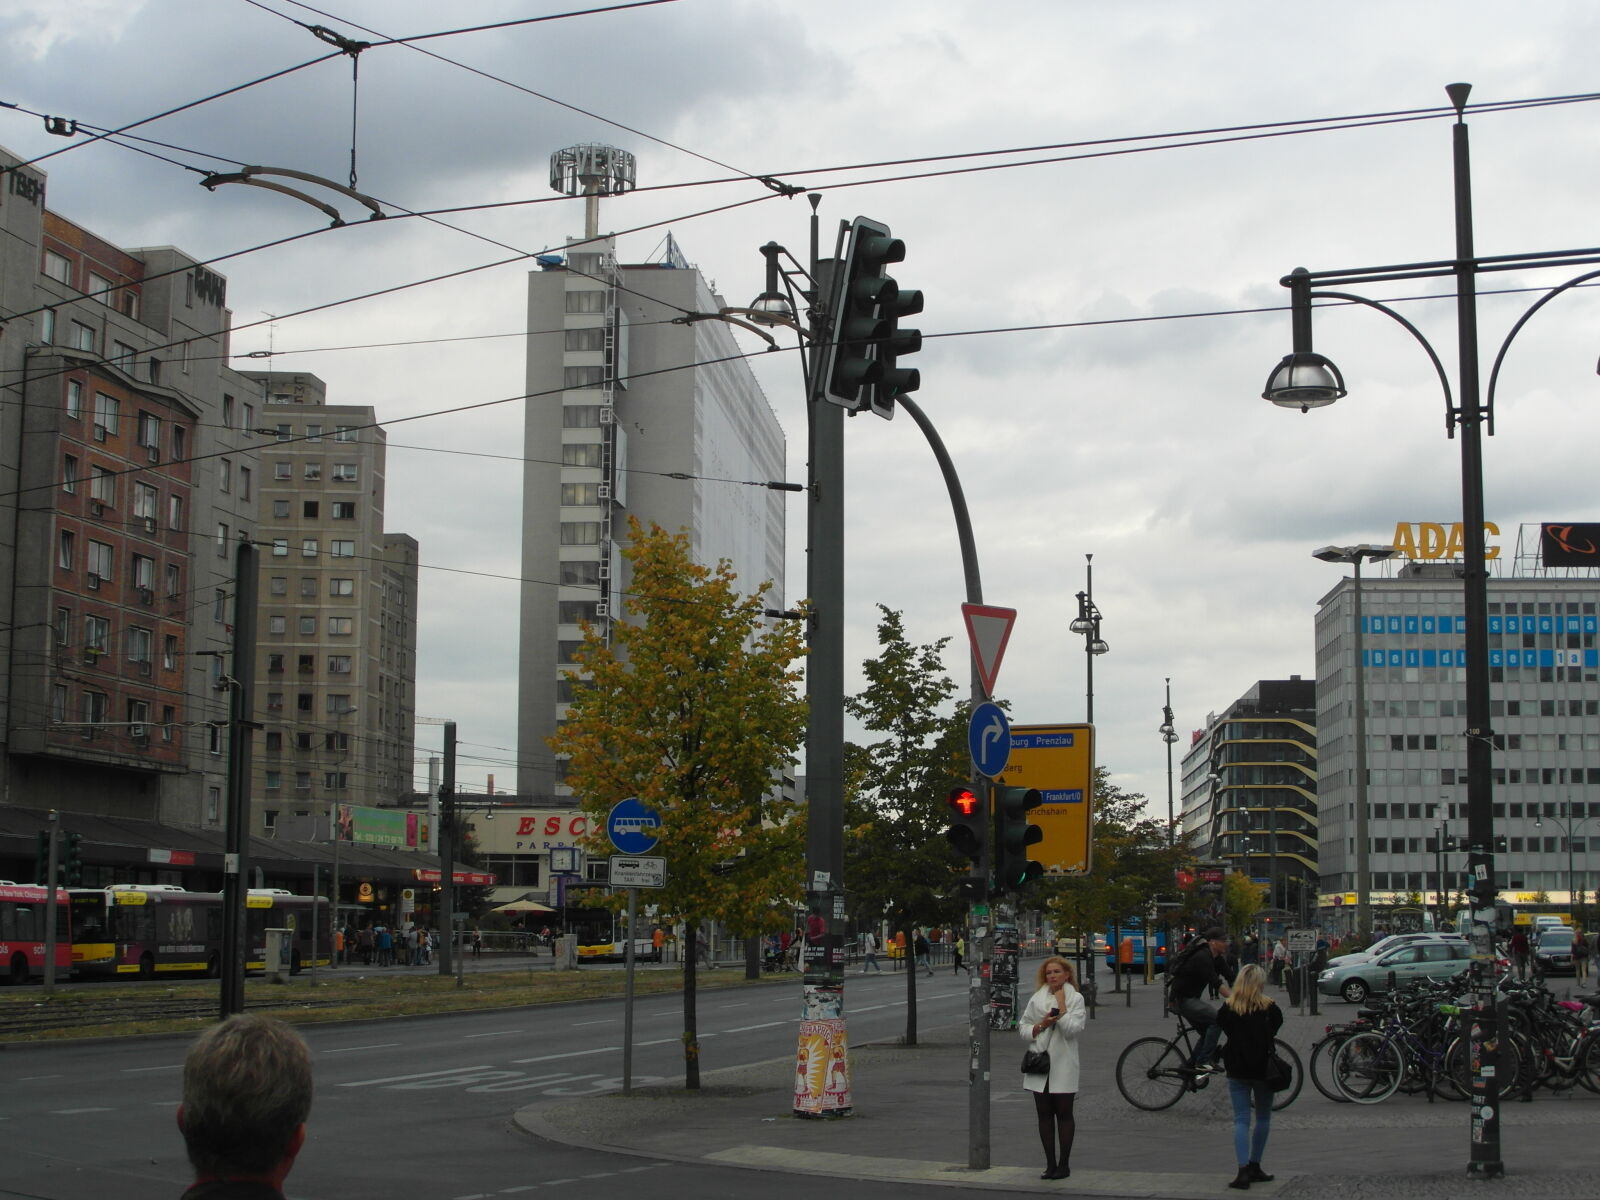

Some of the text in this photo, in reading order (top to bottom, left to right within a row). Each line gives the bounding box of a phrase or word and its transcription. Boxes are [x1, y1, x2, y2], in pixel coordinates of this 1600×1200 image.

[1374, 619, 1432, 631] Büro
[1375, 652, 1578, 664] Bei diser 1a
